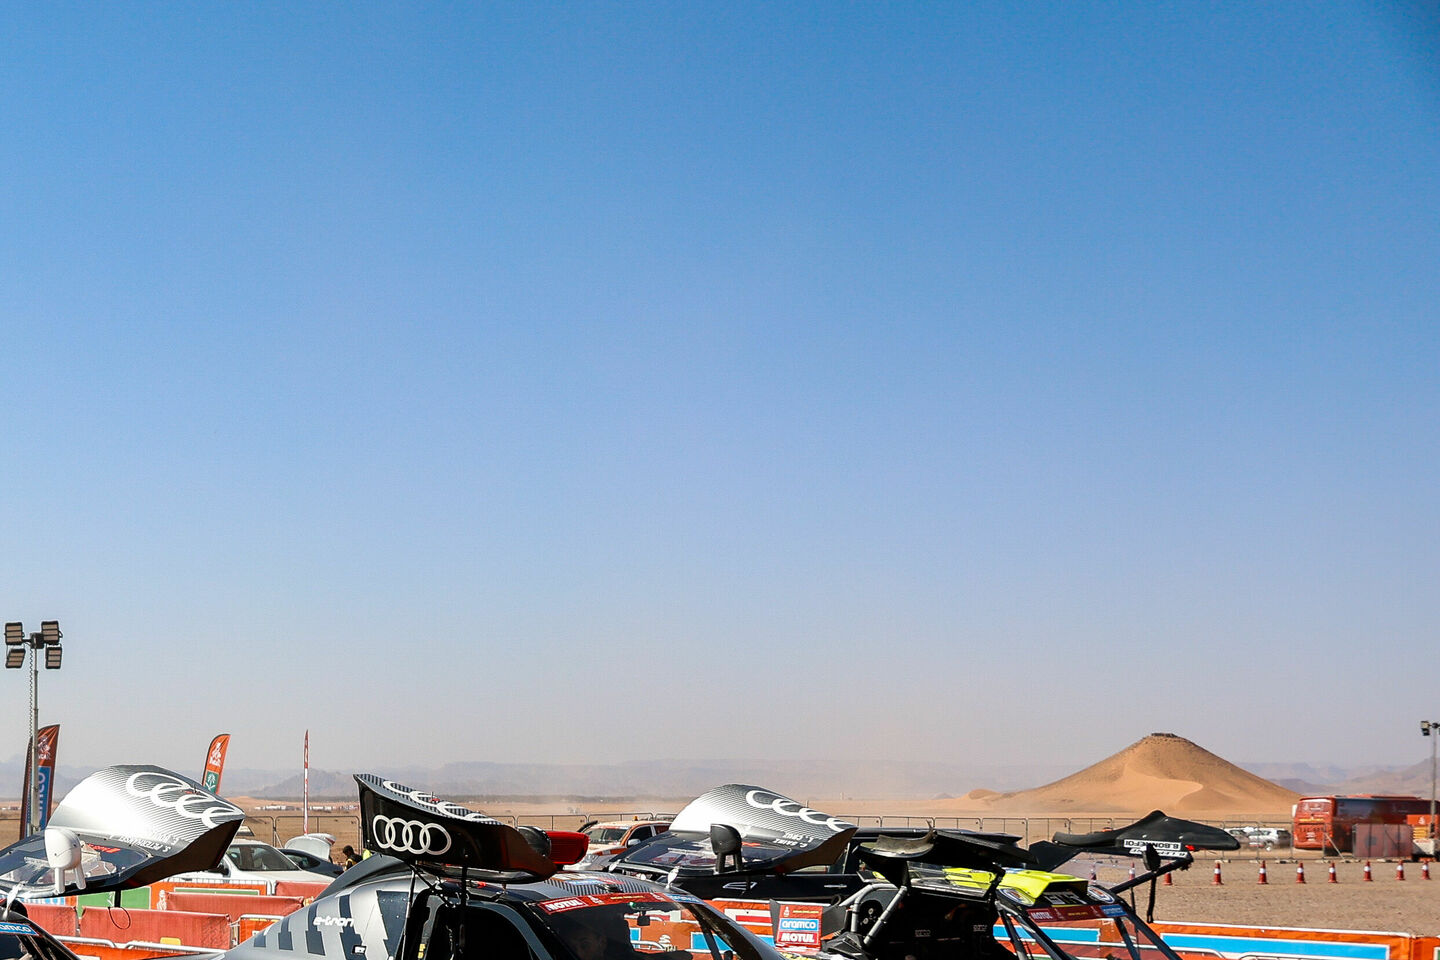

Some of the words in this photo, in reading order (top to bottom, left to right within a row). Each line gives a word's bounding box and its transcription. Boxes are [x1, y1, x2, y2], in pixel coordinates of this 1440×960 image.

[545, 898, 582, 911] MOTUL
[313, 915, 355, 927] e-tron
[781, 920, 816, 929] aramco
[780, 932, 815, 943] MOTUL
